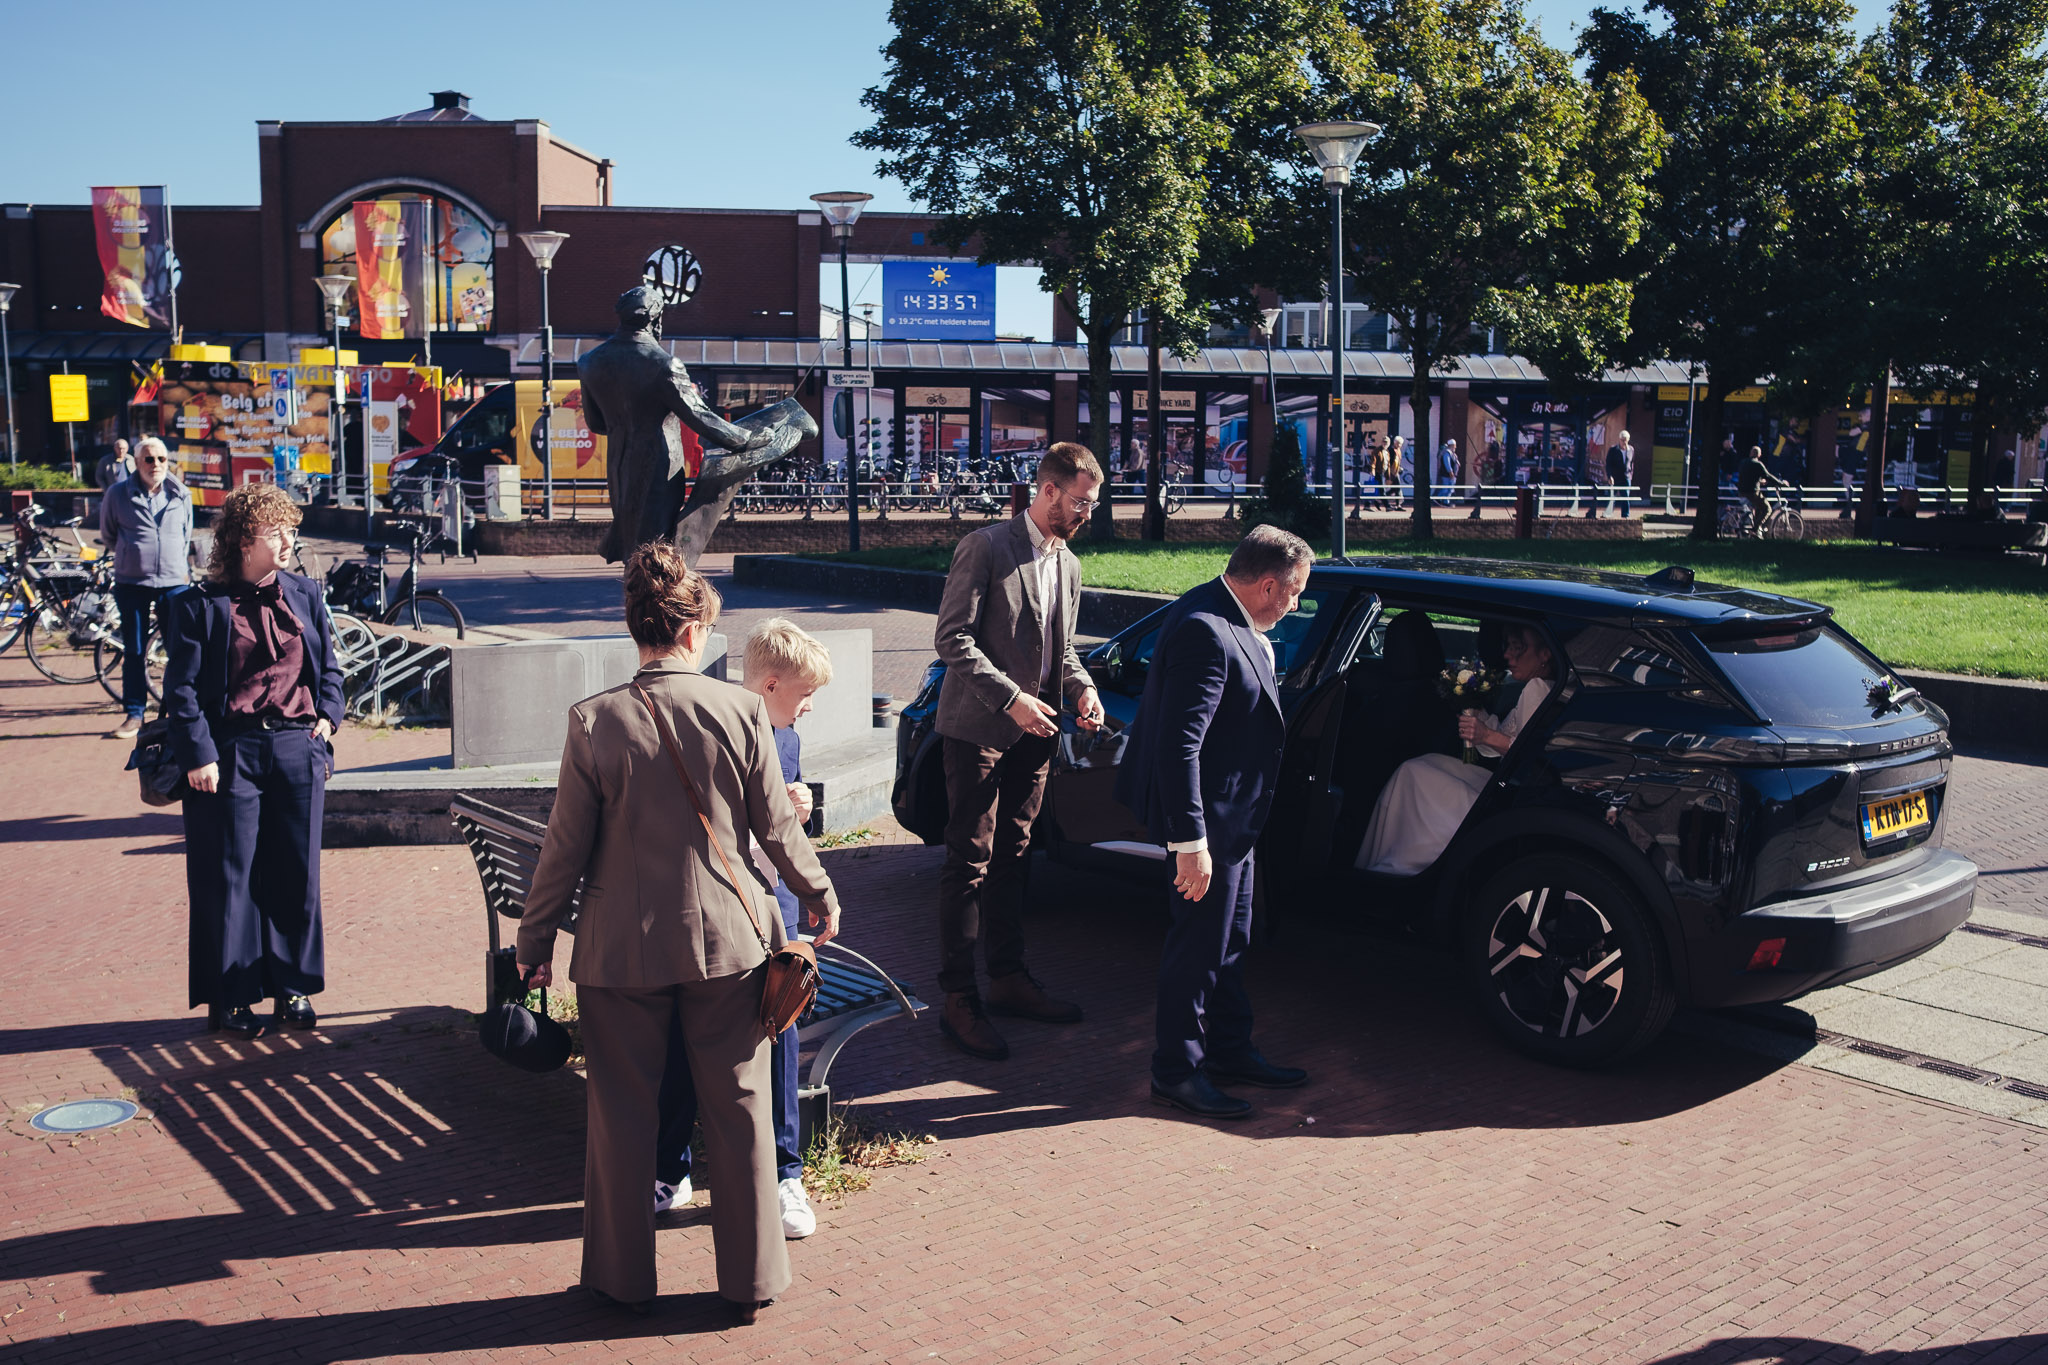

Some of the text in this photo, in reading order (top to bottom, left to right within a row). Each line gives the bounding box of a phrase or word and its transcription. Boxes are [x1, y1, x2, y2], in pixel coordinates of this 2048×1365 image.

[904, 294, 977, 310] 14:33:57
[940, 318, 967, 326] heldere
[968, 318, 990, 326] hemel
[209, 363, 232, 379] de
[221, 392, 254, 413] Belg
[1174, 399, 1191, 407] YARD
[558, 429, 589, 439] BELG
[1874, 796, 1923, 831] KTN-17-S
